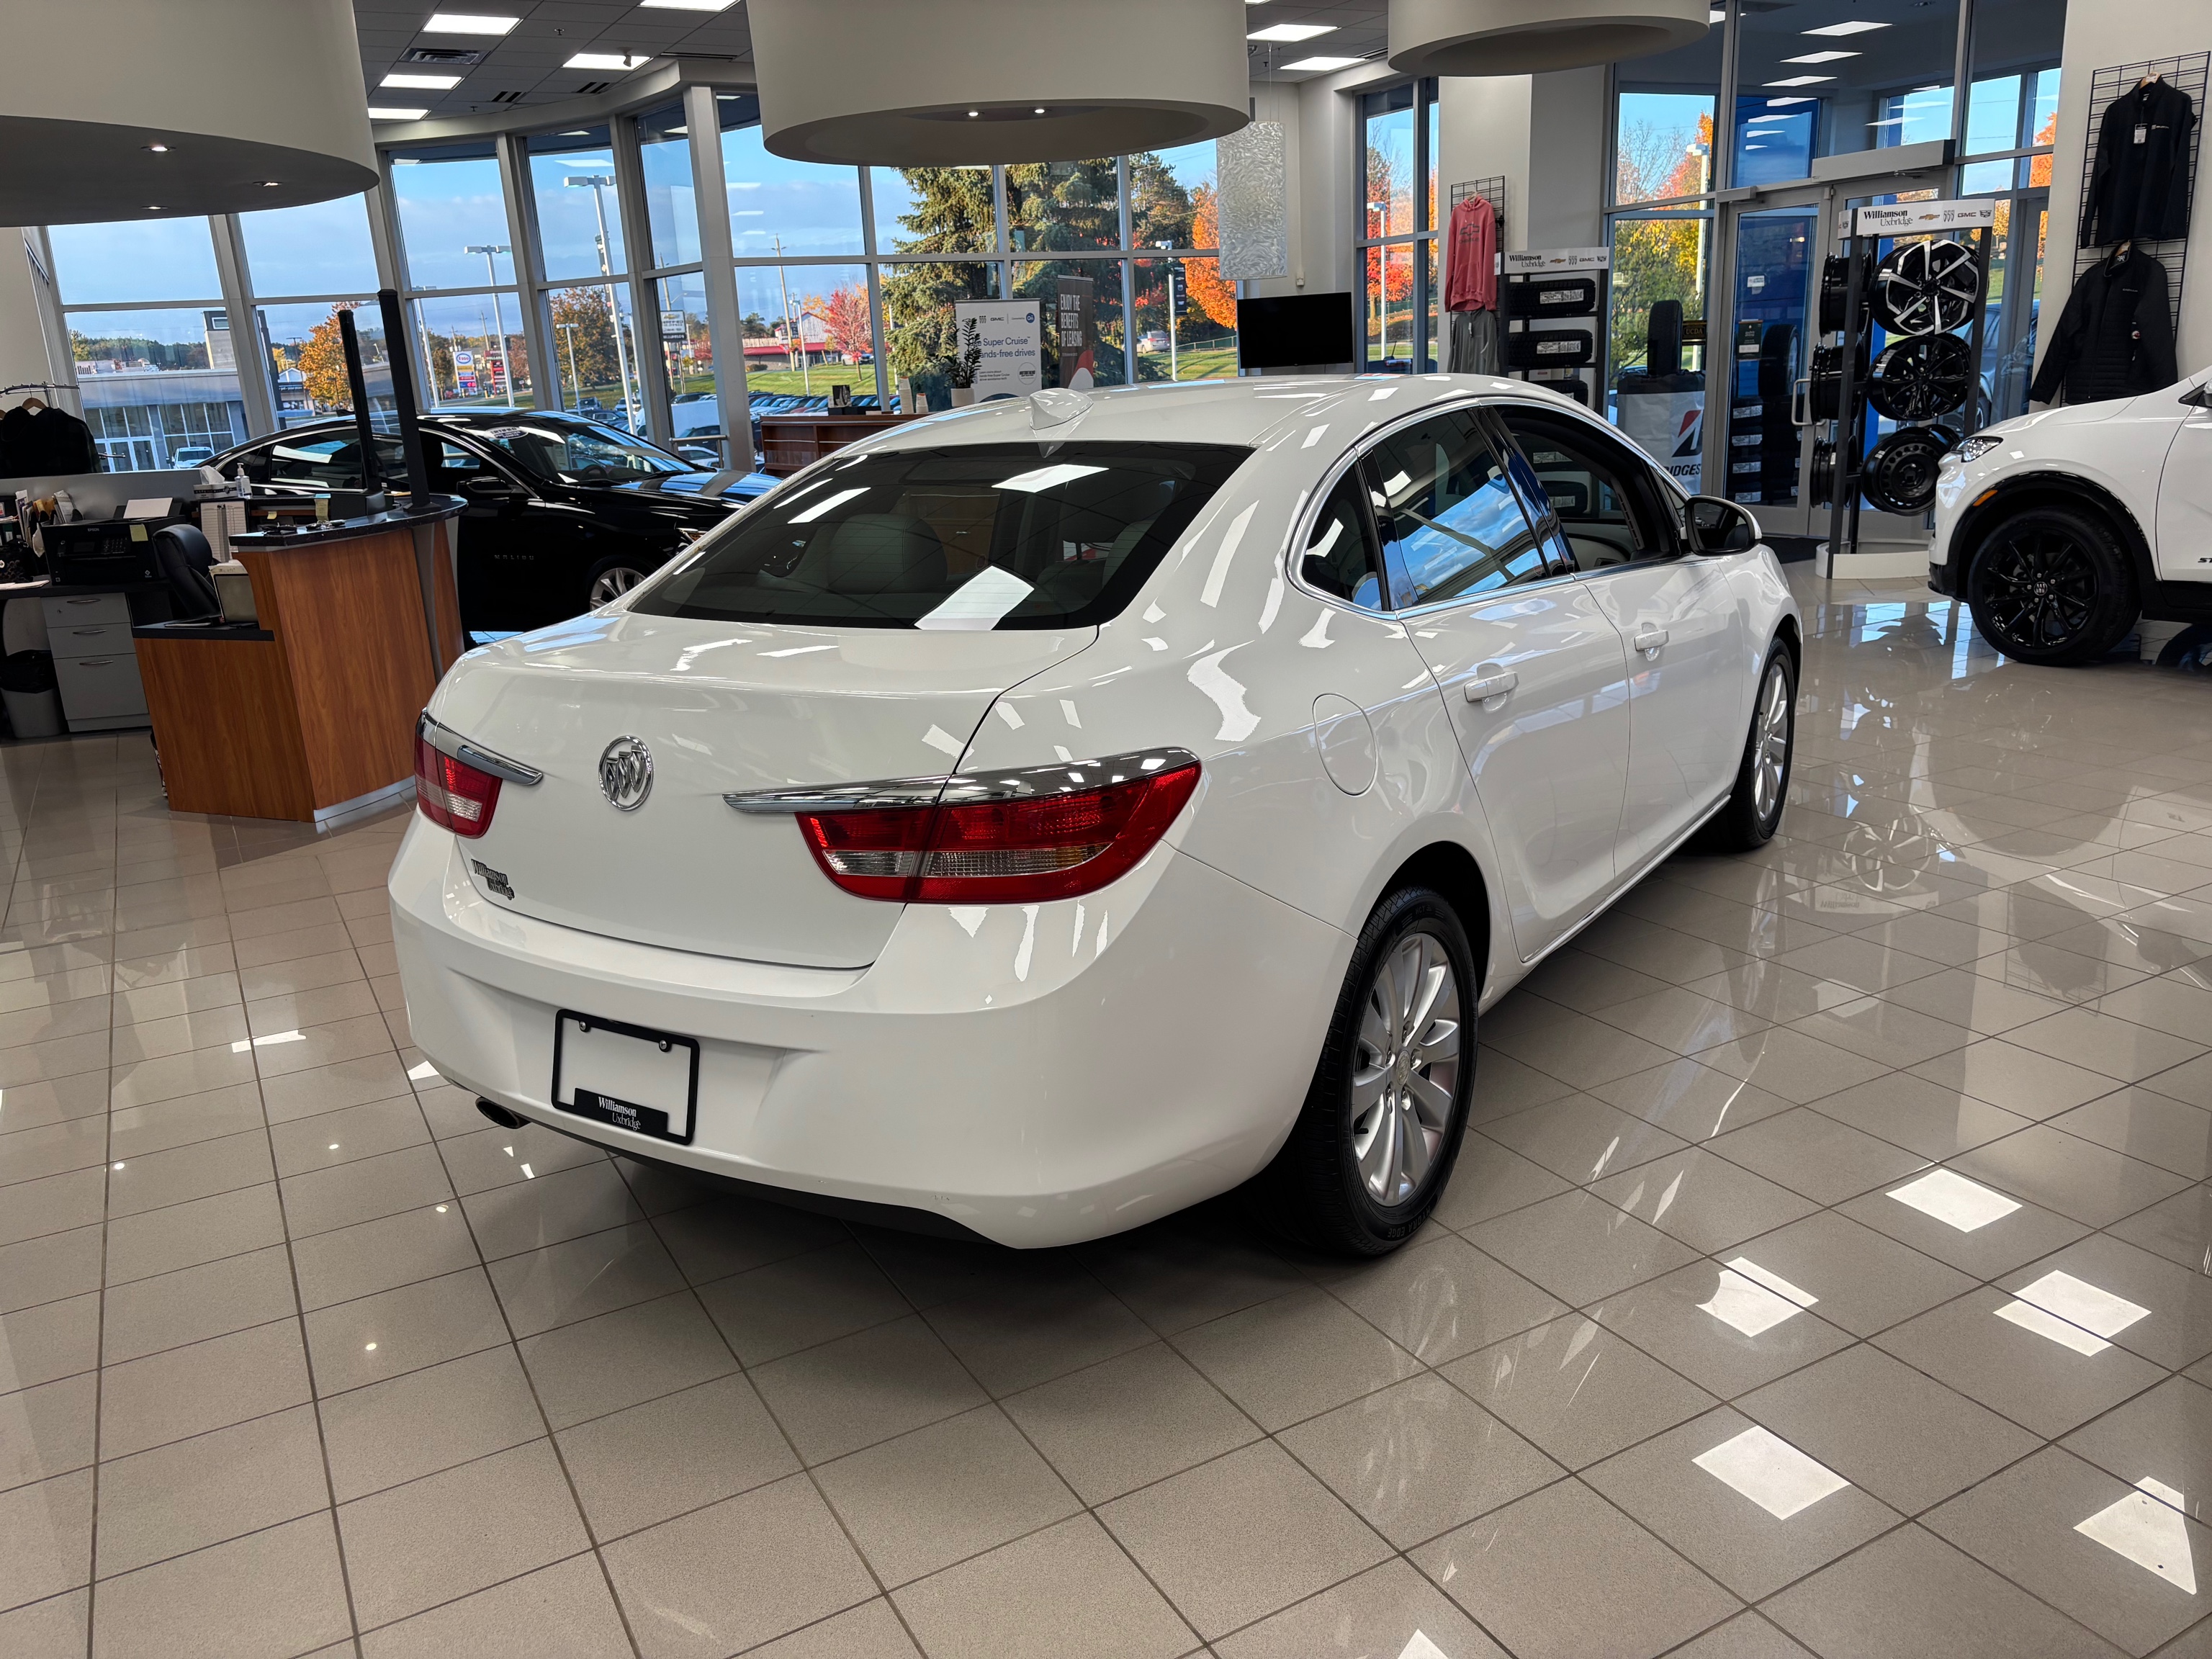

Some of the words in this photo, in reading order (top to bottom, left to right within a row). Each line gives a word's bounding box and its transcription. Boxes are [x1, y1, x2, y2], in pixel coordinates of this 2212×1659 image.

[1863, 210, 1907, 220] Williamson
[1880, 216, 1913, 227] Uxbridge
[1060, 294, 1072, 310] ENJOY
[1061, 313, 1079, 329] BENEFITS
[983, 338, 1004, 347] Super
[1061, 331, 1066, 347] OF
[1066, 331, 1082, 347] LEASING
[977, 349, 1013, 359] ands-free
[471, 858, 508, 885] Williamson
[598, 1096, 637, 1118] Williamson
[612, 1112, 642, 1131] Uxbridge
[1408, 1205, 1431, 1233] HYDRA
[1387, 1226, 1406, 1238] EDGE
